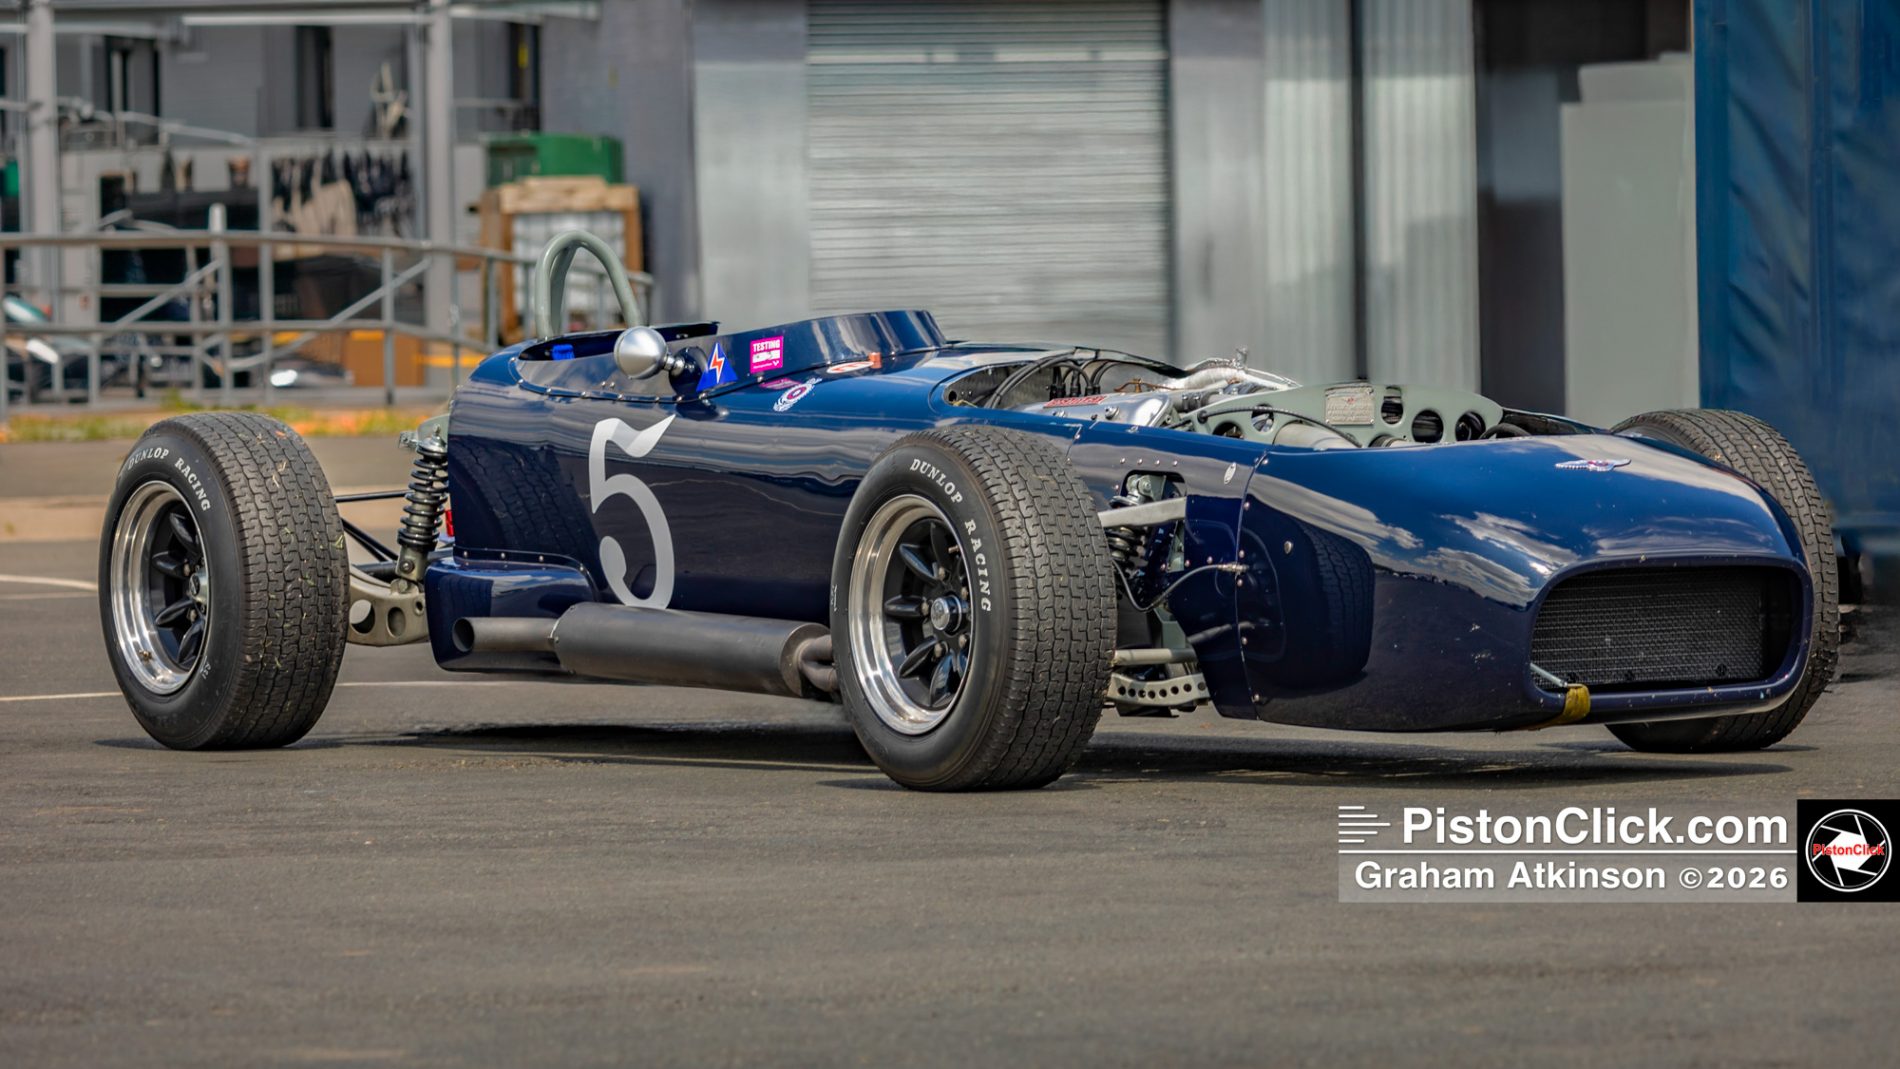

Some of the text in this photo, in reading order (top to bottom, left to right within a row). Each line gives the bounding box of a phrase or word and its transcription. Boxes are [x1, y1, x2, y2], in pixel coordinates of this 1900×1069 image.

[753, 339, 780, 352] TESTING
[127, 447, 211, 511] DUNLOP RACING
[588, 413, 676, 610] 5
[910, 458, 992, 612] DUNLOP RACING
